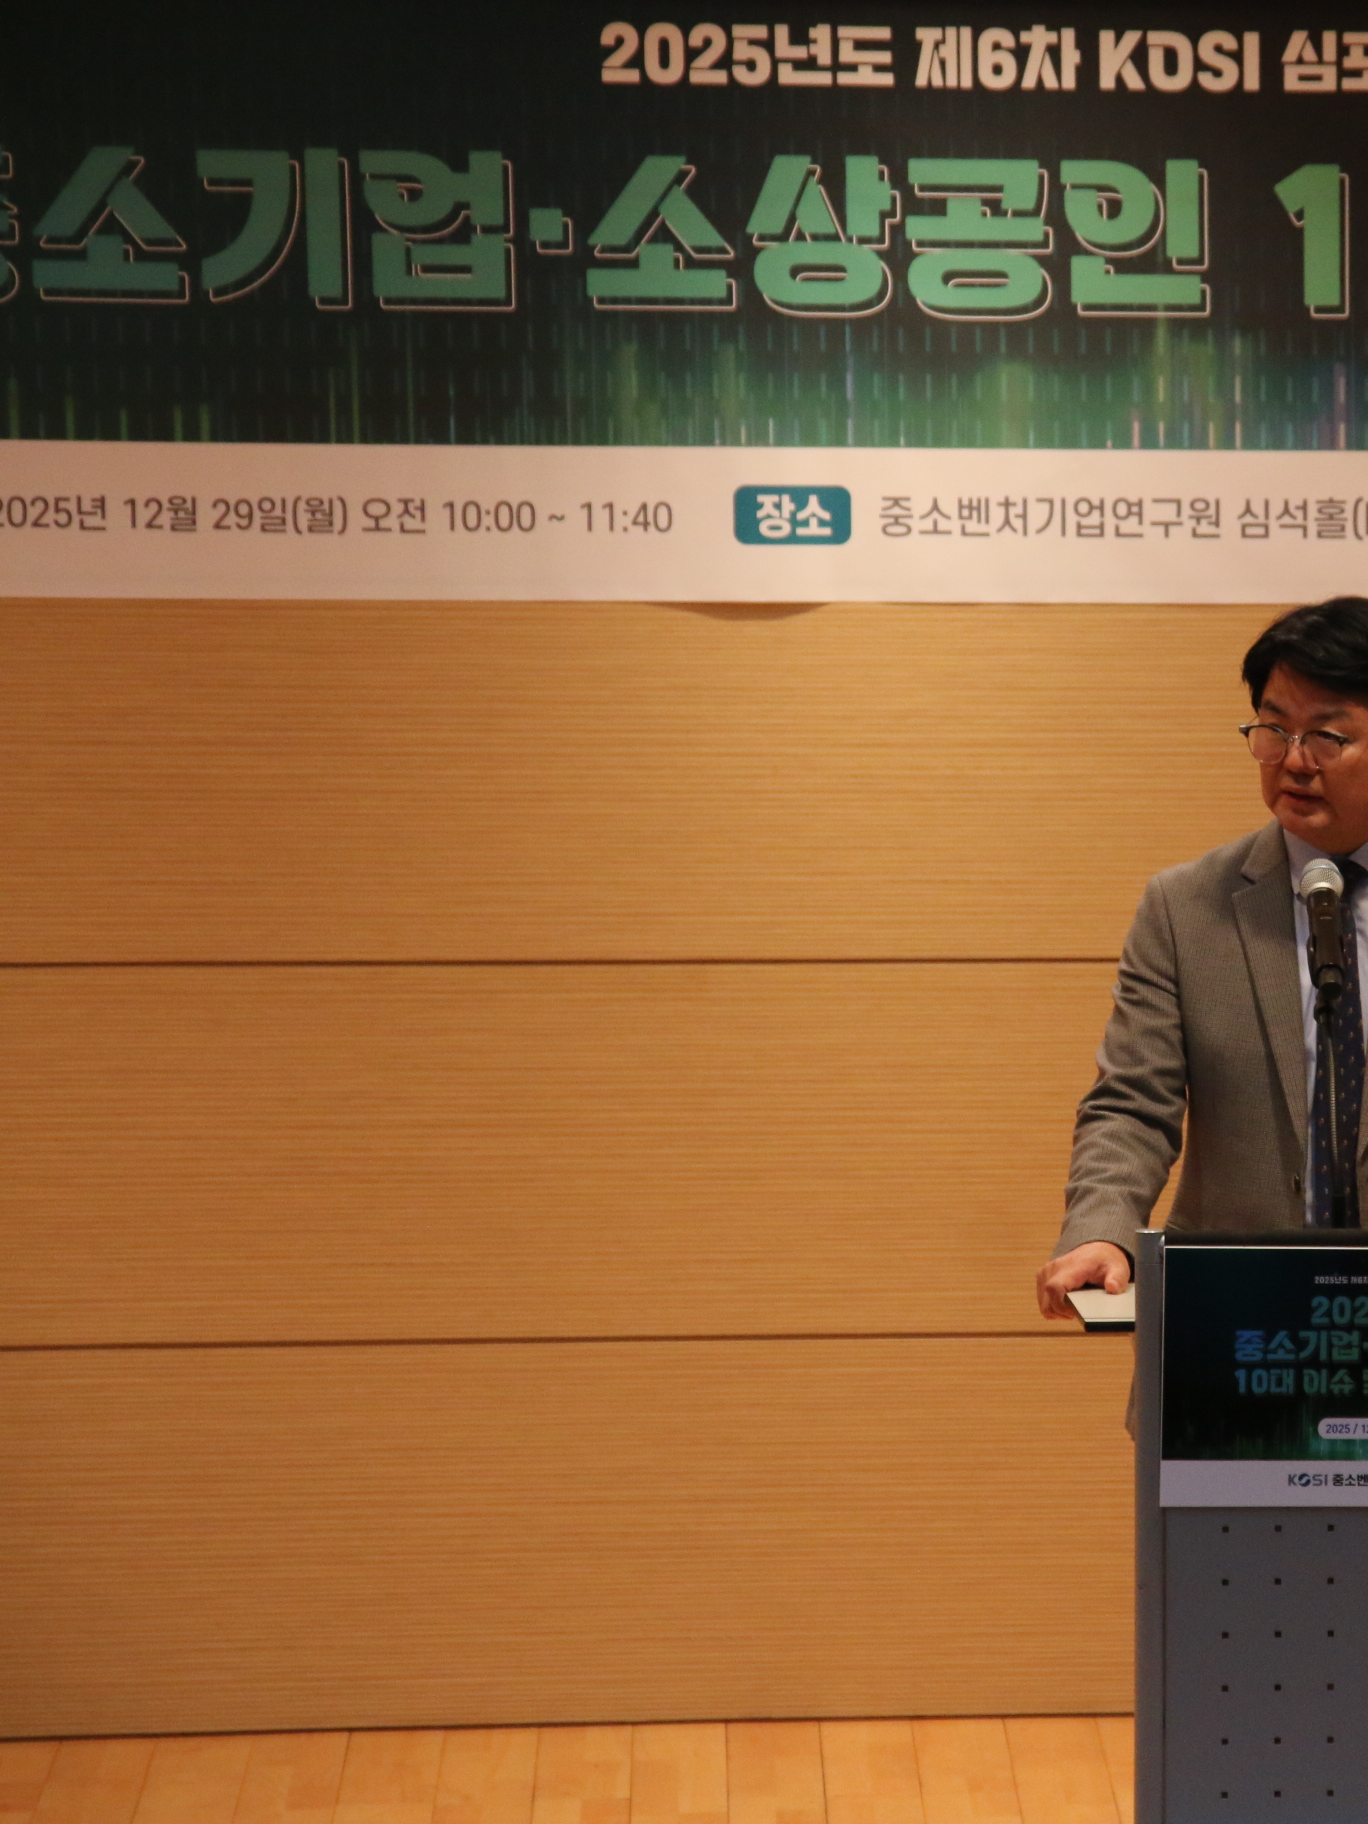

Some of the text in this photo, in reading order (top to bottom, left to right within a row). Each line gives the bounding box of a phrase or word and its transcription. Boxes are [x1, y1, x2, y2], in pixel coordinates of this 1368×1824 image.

[600, 21, 895, 87] 2025년도
[914, 24, 1081, 91] 제6차
[0, 145, 1210, 322] 소기업·소상공인
[0, 494, 107, 531] 025년
[123, 495, 197, 532] 12월
[211, 496, 348, 535] 29일(월)
[361, 496, 427, 534] 오전
[442, 500, 536, 532] 10:00
[580, 502, 674, 533] 11:40
[755, 493, 833, 539] 장소
[878, 496, 1222, 540] 중소벤처기업연구원
[1314, 1275, 1349, 1285] 2025년도
[1234, 1368, 1296, 1396] 10대
[1302, 1368, 1356, 1396] 이슈
[1326, 1424, 1351, 1434] 2025
[1288, 1473, 1328, 1487] KOSI
